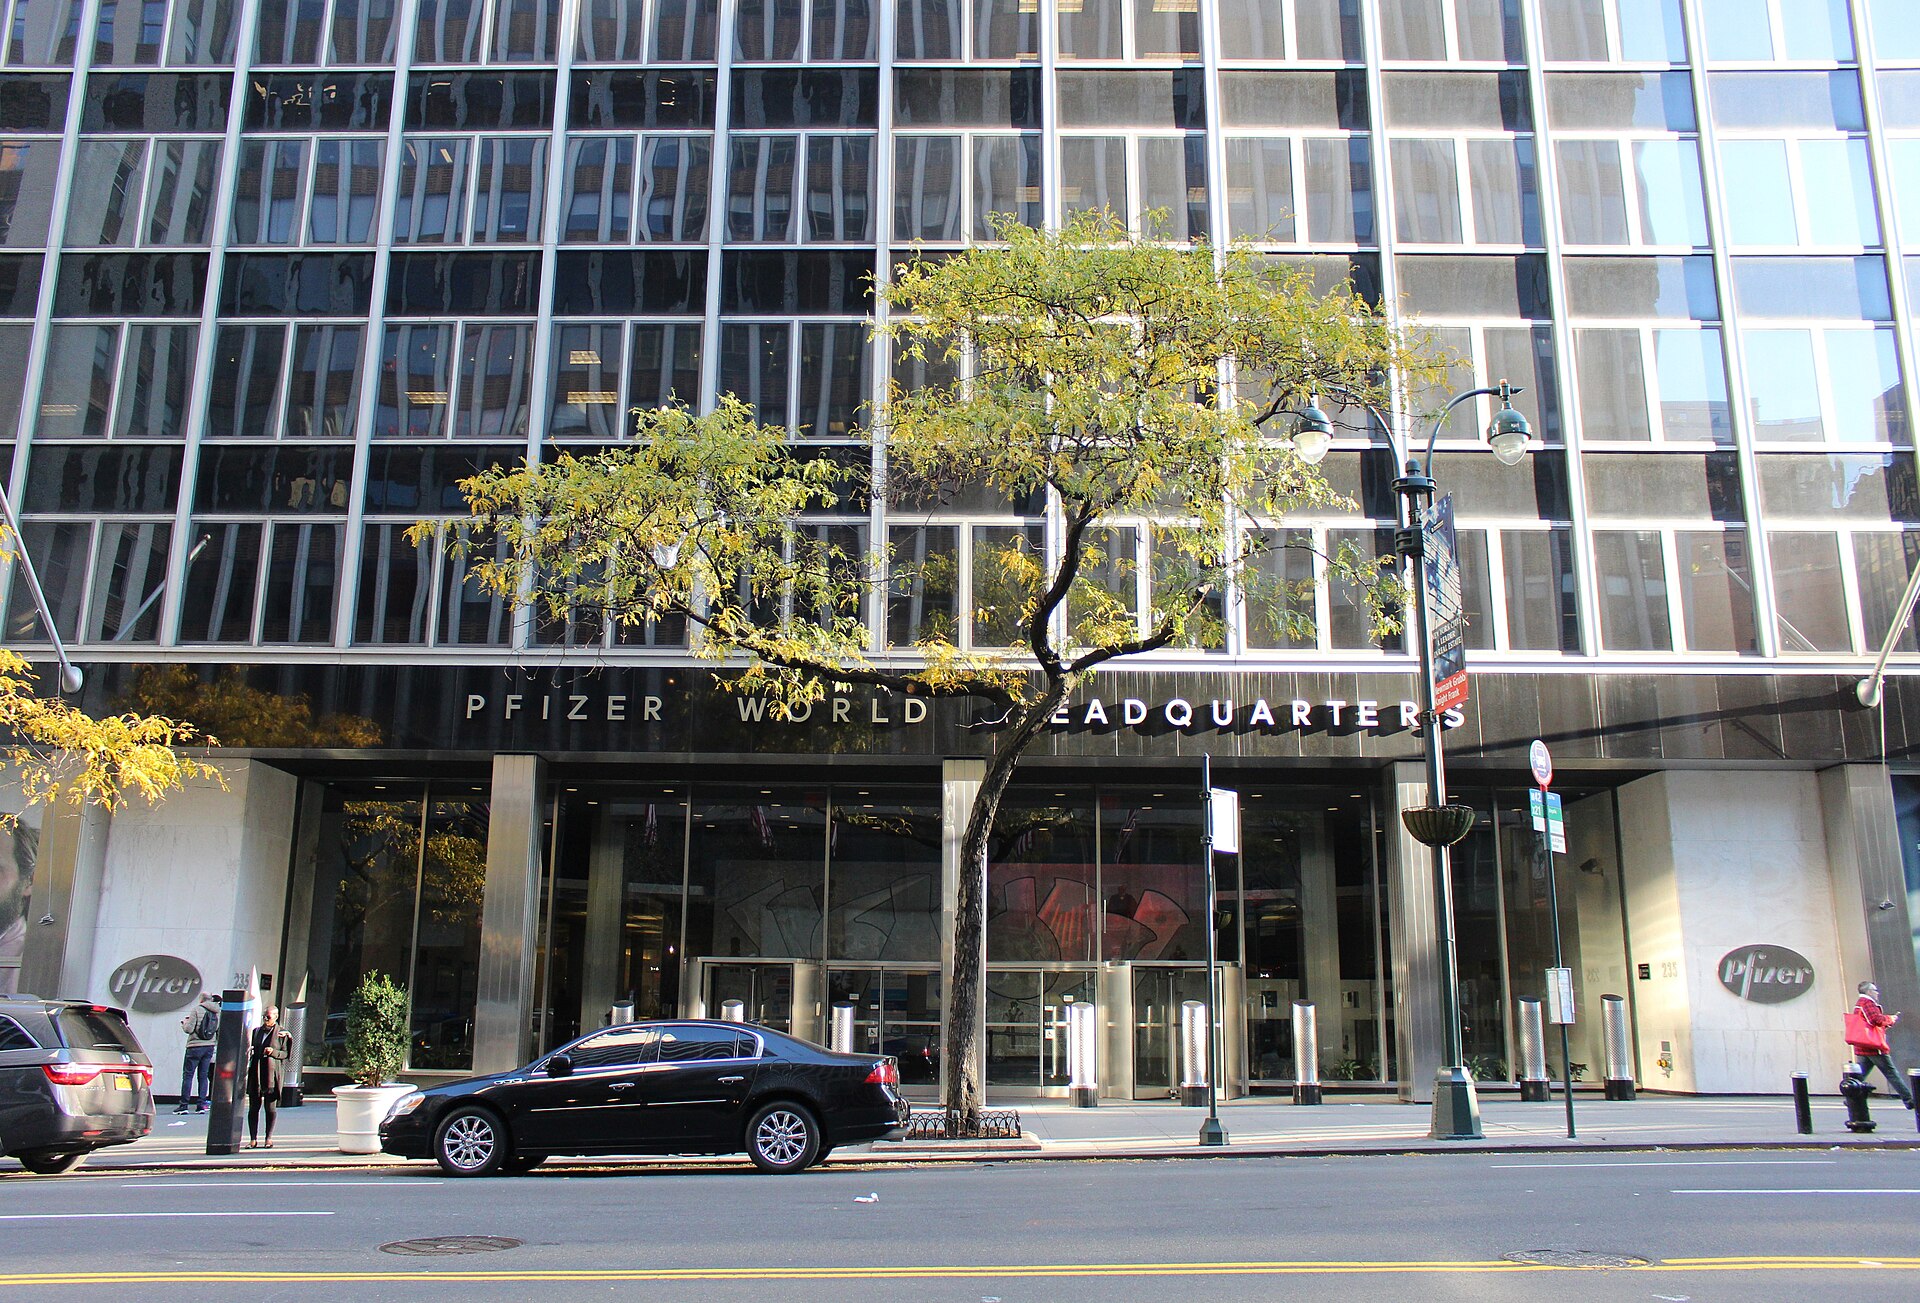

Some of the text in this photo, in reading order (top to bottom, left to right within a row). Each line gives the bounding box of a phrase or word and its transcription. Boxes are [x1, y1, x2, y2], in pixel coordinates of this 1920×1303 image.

[466, 694, 1465, 728] PFIZER WORLD EADQUARTERS
[114, 961, 201, 1009] Pfizer
[233, 972, 250, 989] 235
[1661, 962, 1678, 978] 235
[1723, 950, 1812, 1000] Pfizer
